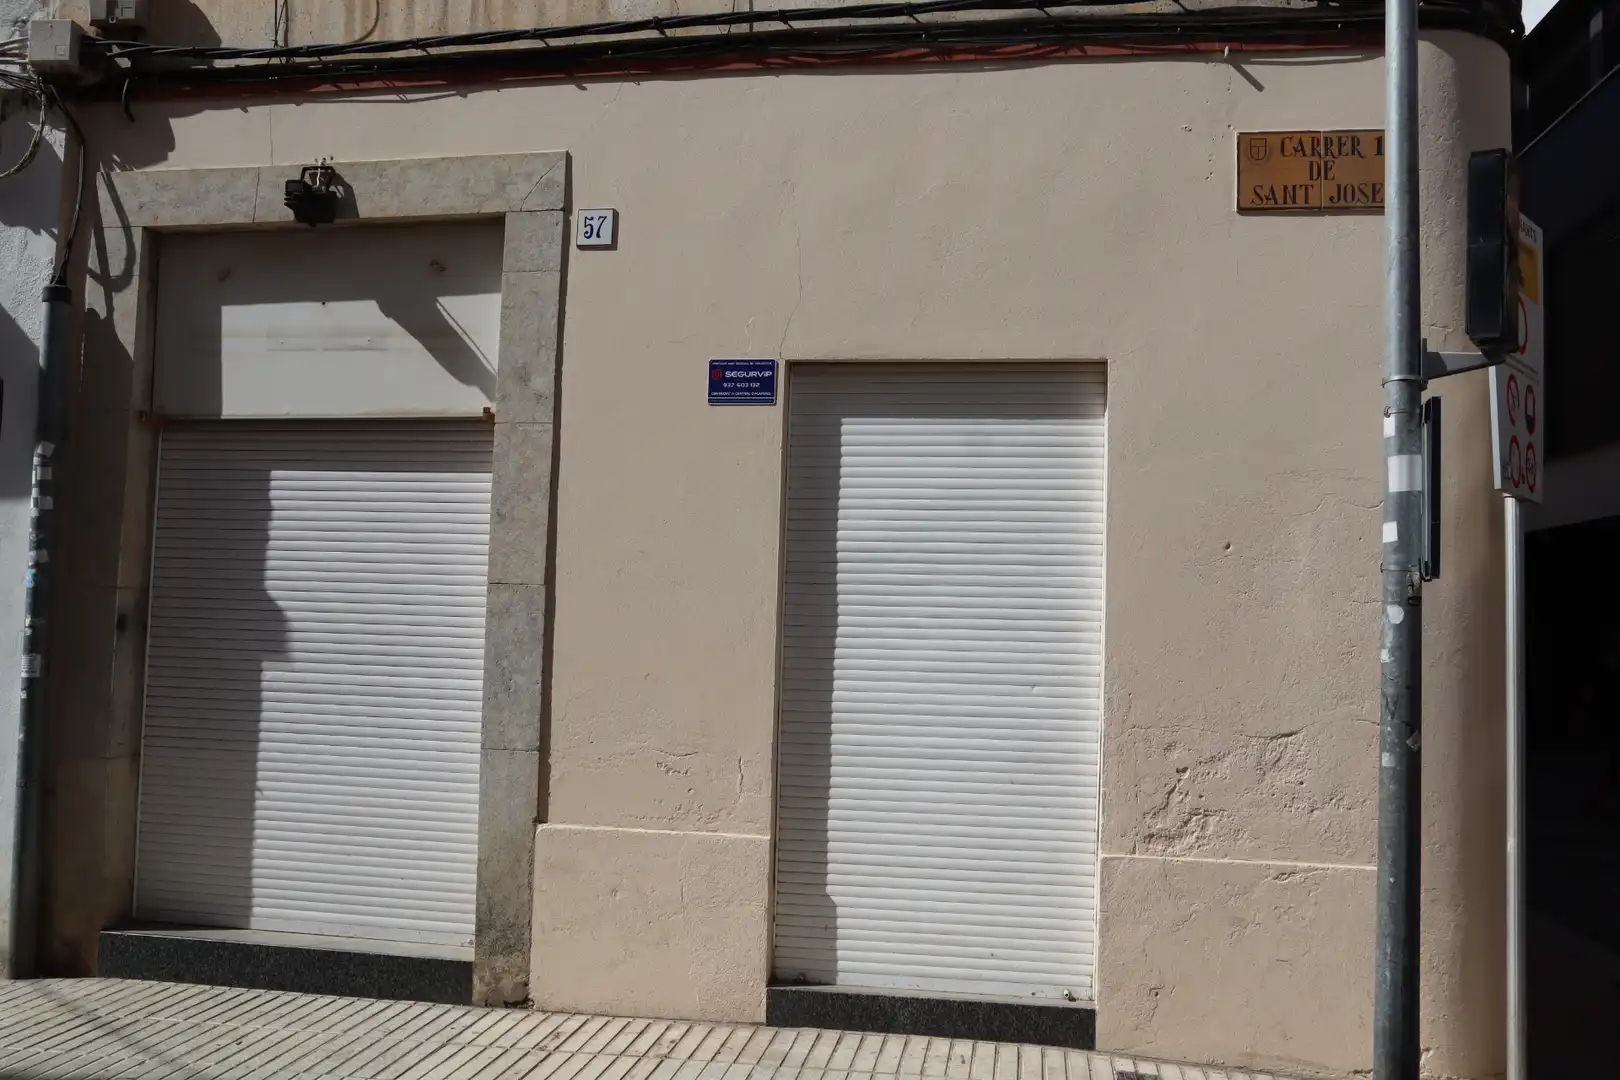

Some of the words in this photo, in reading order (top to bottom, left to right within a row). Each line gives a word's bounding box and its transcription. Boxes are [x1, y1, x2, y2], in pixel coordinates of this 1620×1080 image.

[1280, 135, 1366, 159] CARRER
[1309, 160, 1336, 181] DE
[1251, 183, 1314, 206] SANT
[1329, 182, 1385, 205] JOSE
[583, 215, 608, 240] 57
